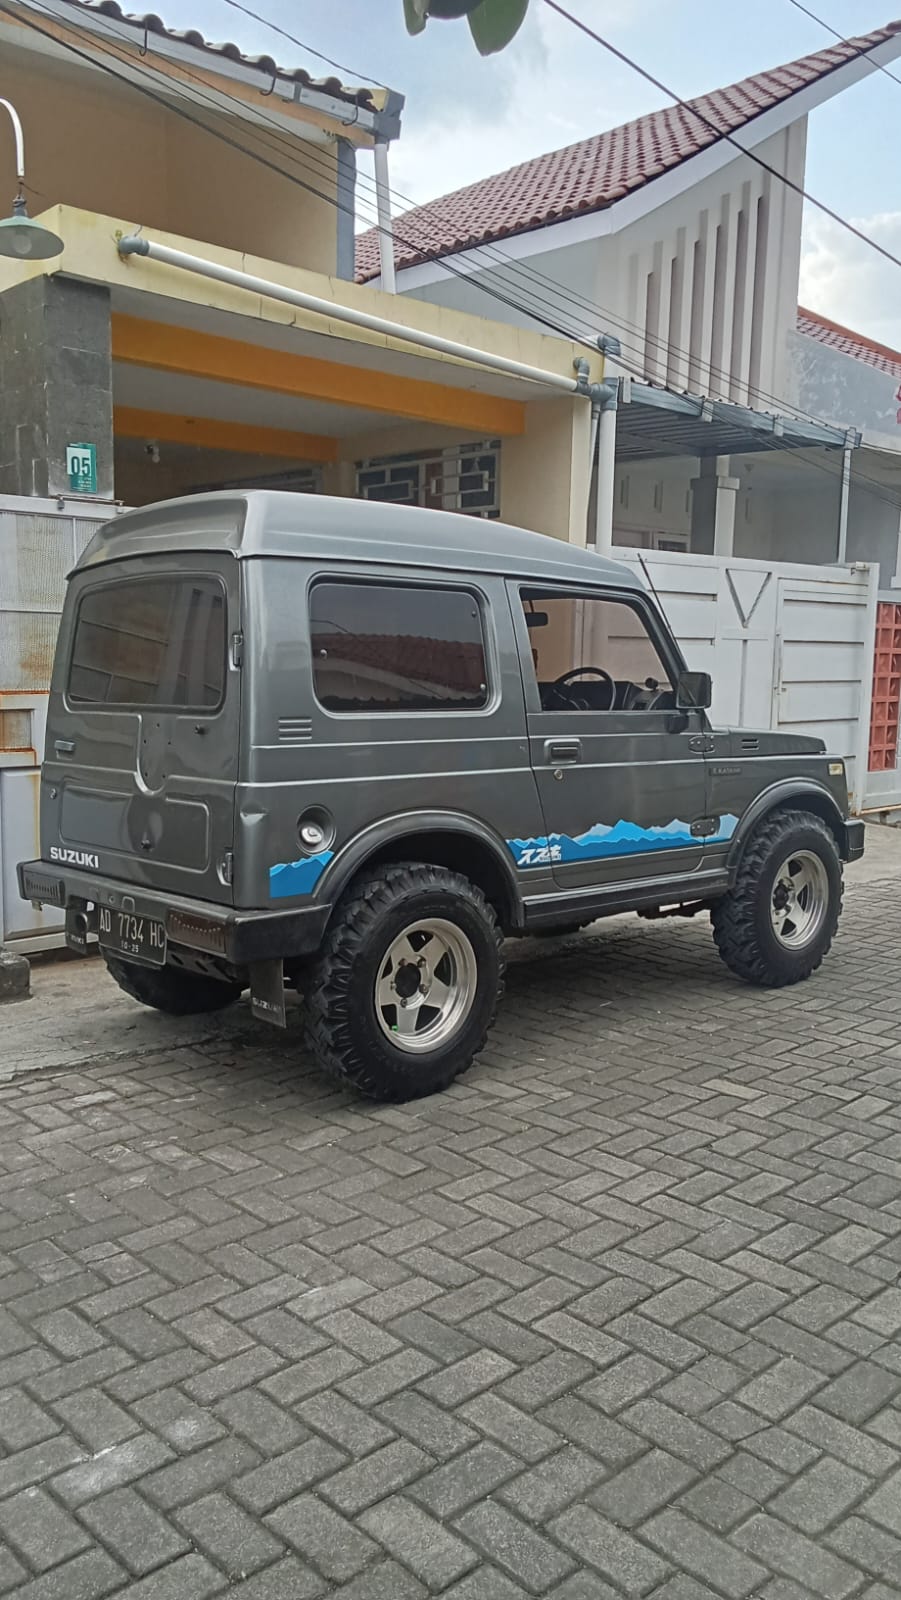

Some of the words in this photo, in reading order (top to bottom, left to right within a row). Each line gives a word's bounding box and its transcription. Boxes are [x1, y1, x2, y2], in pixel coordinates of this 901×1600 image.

[71, 456, 90, 476] 05
[50, 846, 99, 868] SUZUKI
[100, 907, 111, 932] AD
[118, 912, 144, 943] 7734
[150, 920, 165, 948] HC
